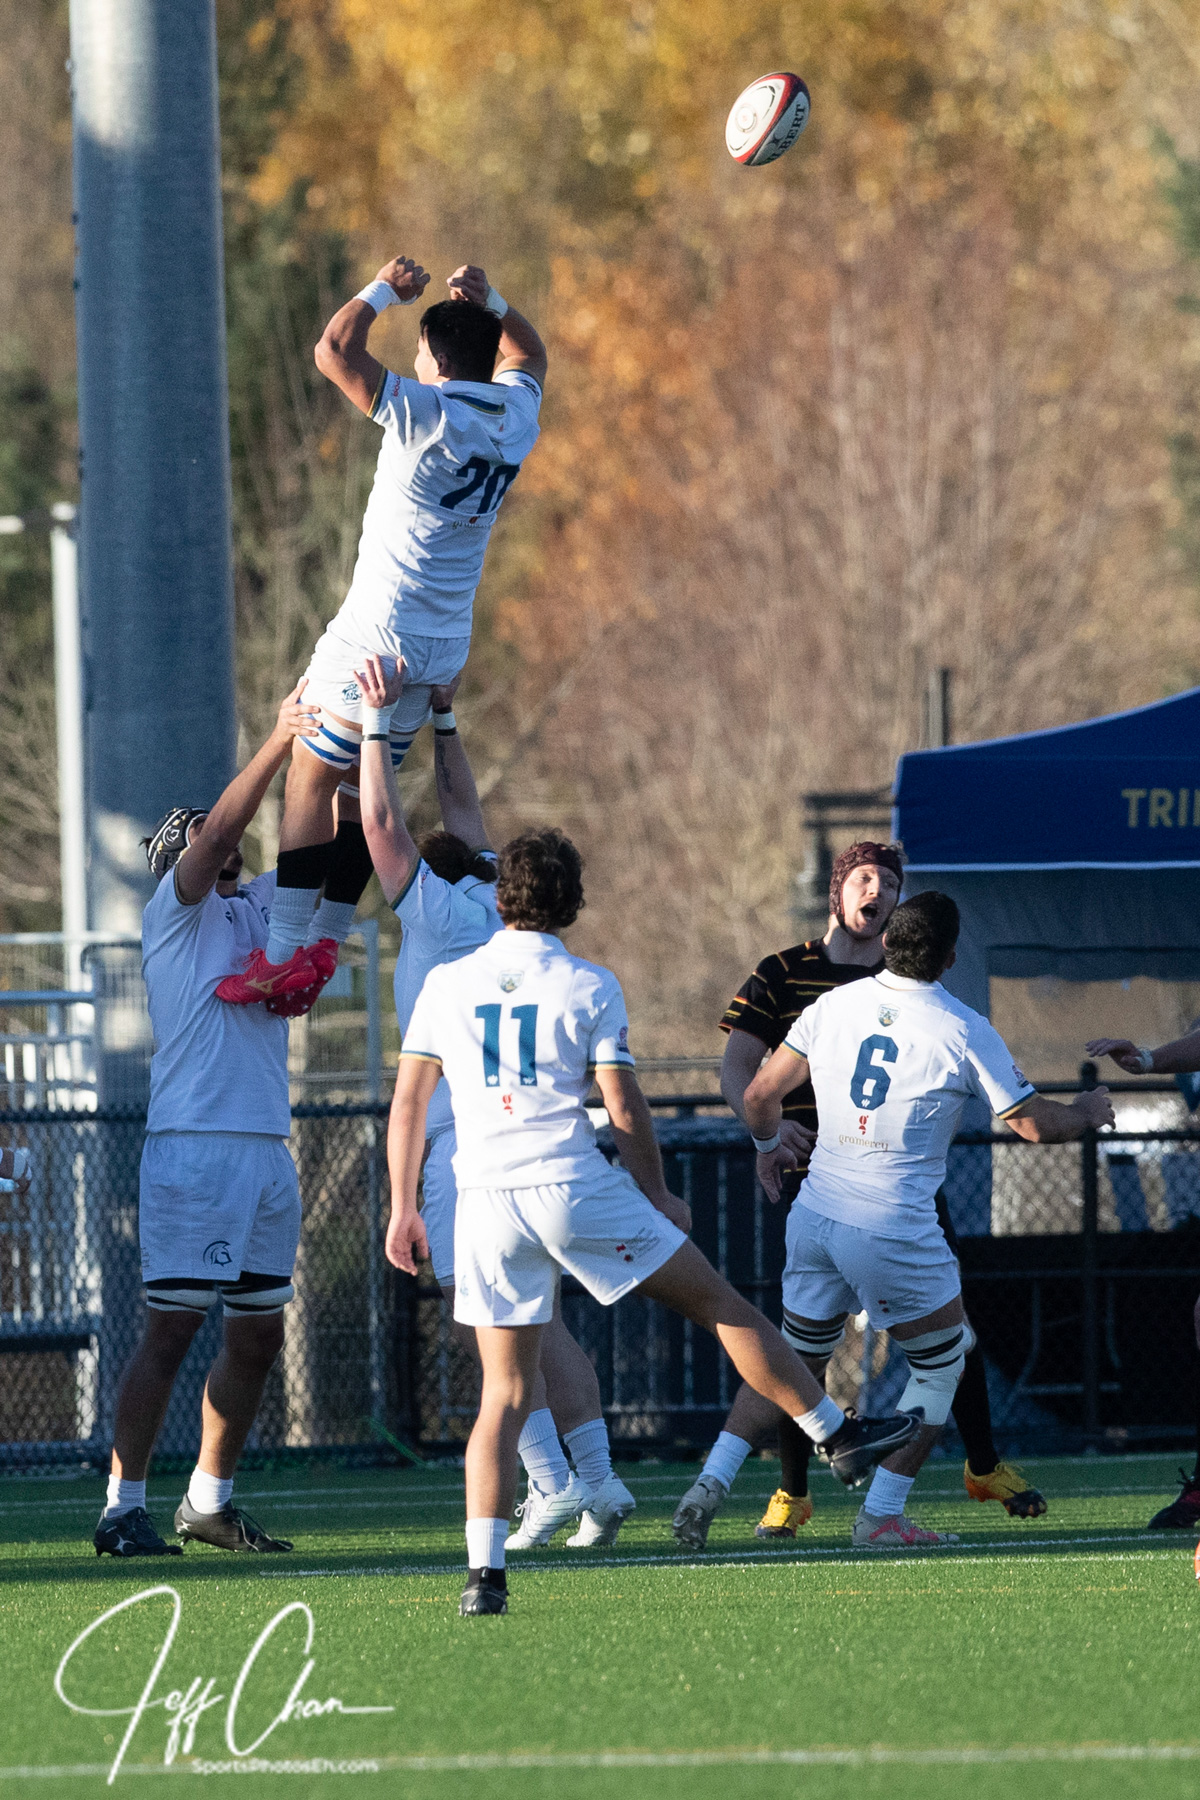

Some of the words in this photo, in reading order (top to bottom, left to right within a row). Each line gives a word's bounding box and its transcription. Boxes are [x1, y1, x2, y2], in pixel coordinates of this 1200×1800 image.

[475, 1003, 539, 1088] 11
[849, 1033, 899, 1111] 6
[838, 1134, 889, 1152] gramercy
